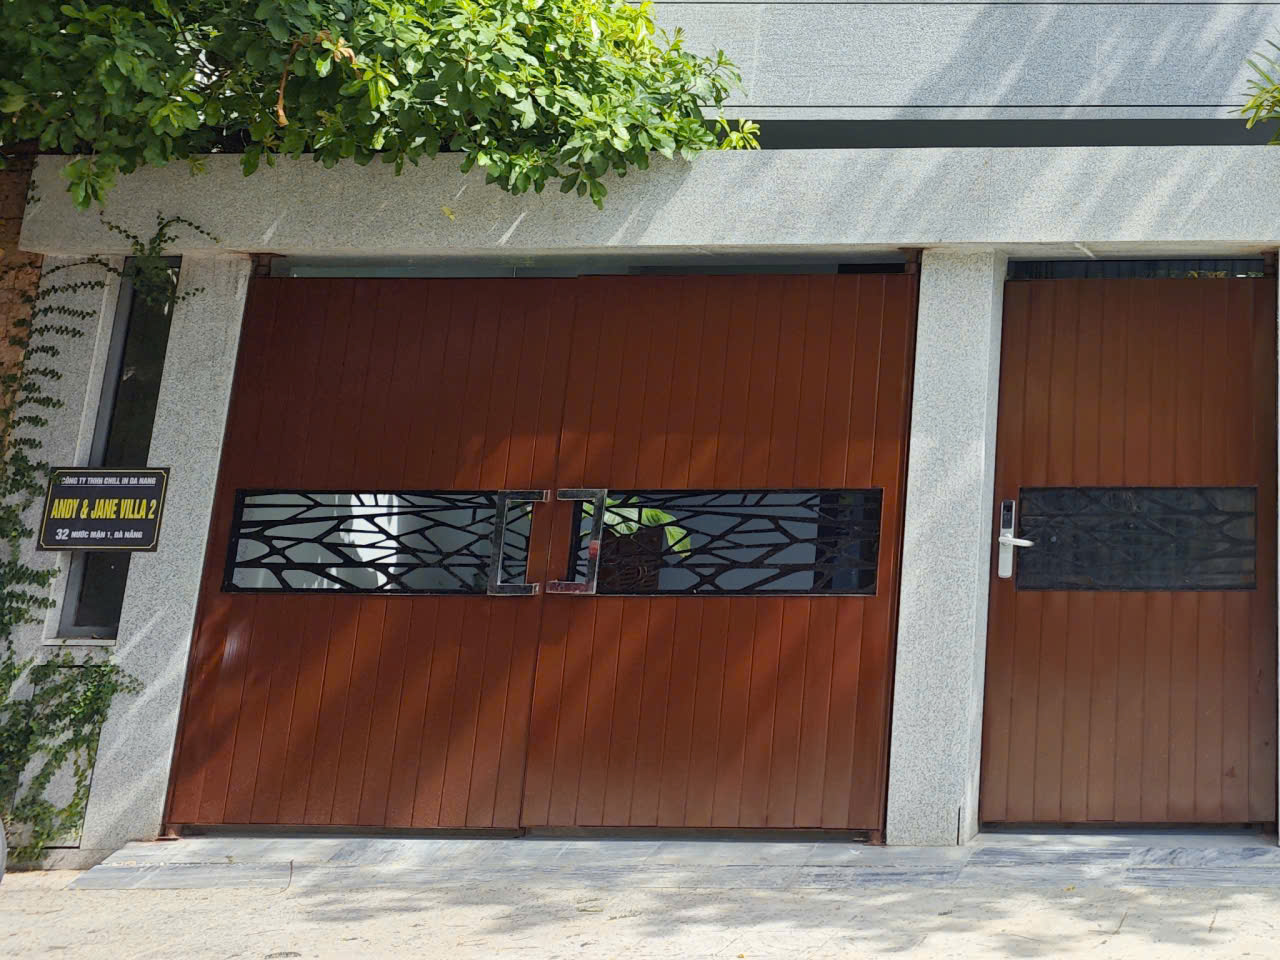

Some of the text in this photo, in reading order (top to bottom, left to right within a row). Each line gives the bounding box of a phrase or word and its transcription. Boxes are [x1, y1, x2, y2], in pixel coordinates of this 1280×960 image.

[79, 477, 87, 485] TY
[50, 498, 157, 519] ANDY & JANE VILLA 2
[55, 528, 70, 540] 32
